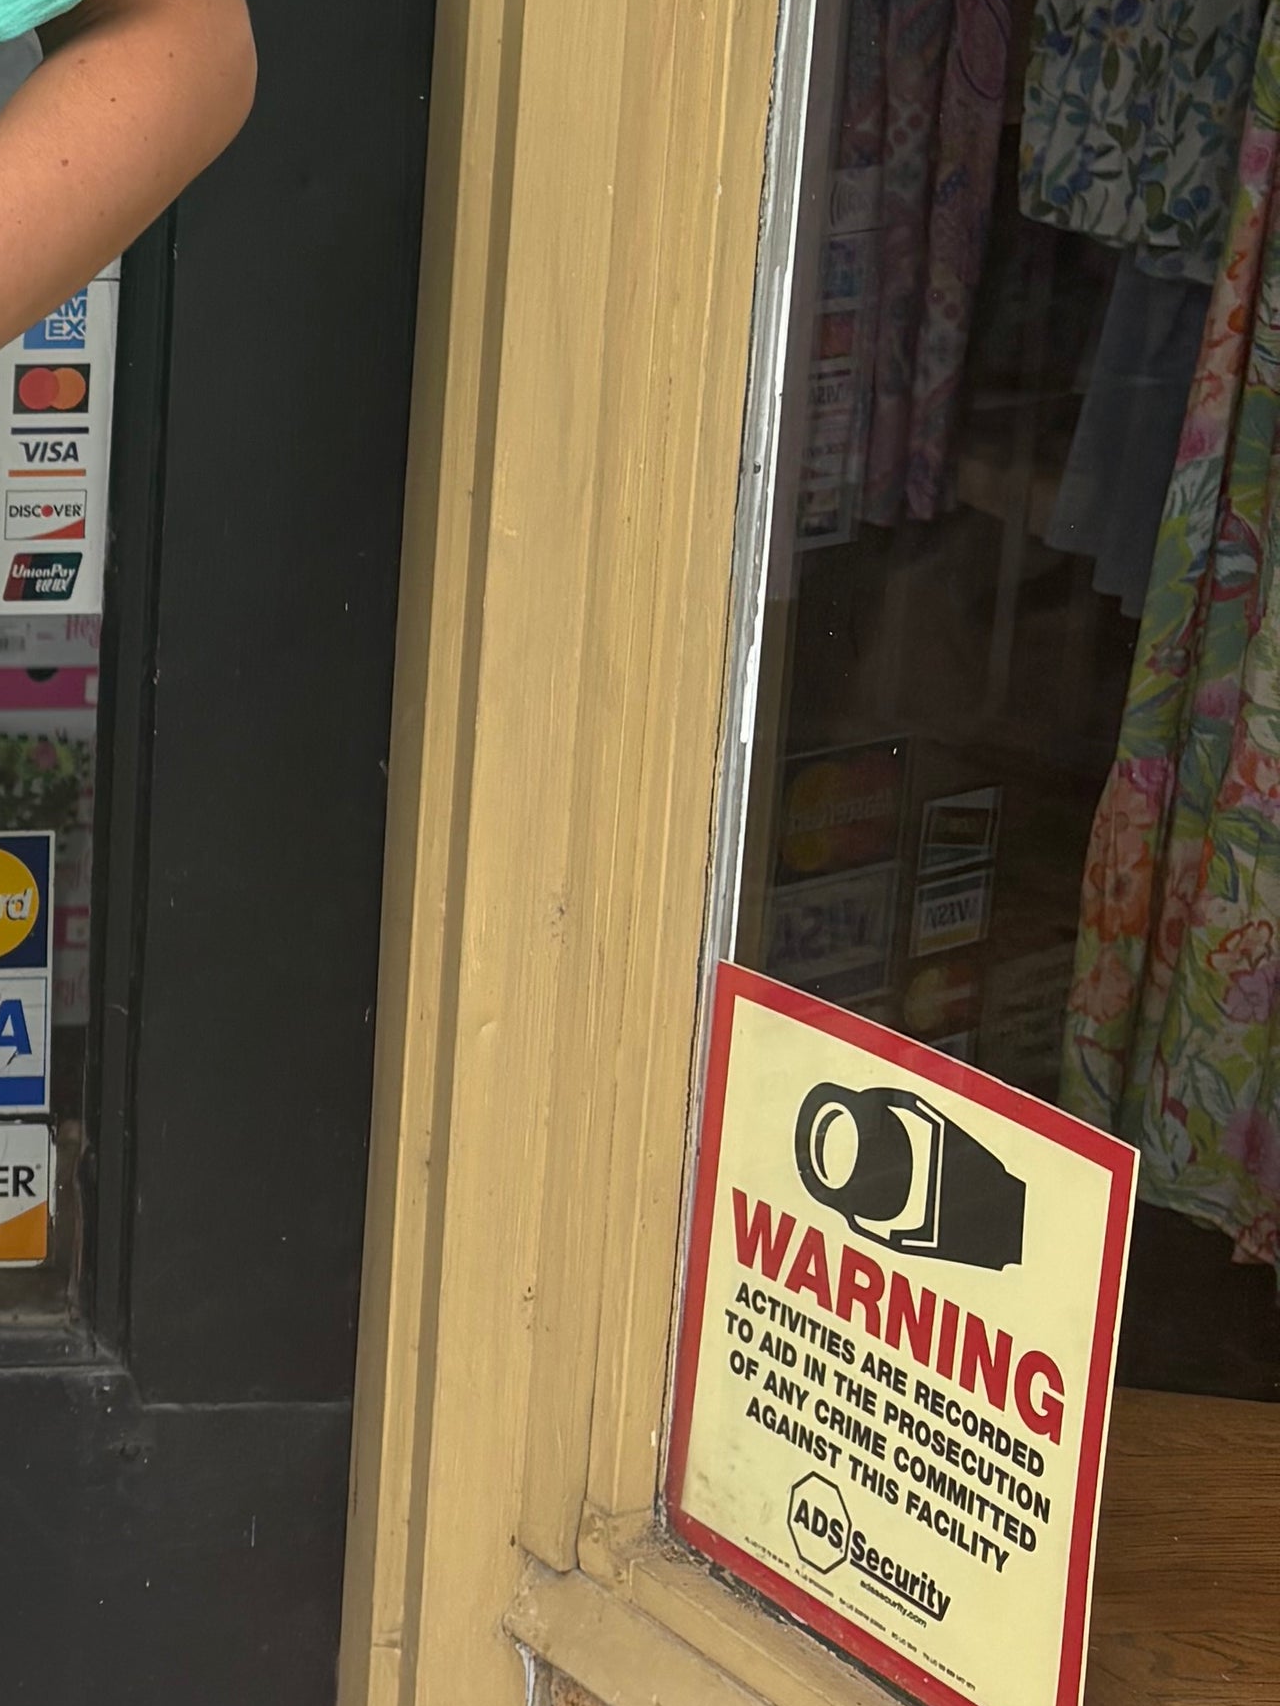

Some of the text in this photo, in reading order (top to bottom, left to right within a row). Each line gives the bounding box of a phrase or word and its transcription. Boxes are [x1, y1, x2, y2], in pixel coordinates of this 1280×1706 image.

[8, 503, 83, 519] DISCOVER
[19, 441, 80, 463] VISA
[12, 562, 76, 581] UnionPay
[732, 1186, 1065, 1446] WARNING
[735, 1282, 1045, 1478] ACTIVITIES ARE RECORDED
[724, 1308, 1051, 1524] TO AID IN THE PROSECUTION
[729, 1349, 1037, 1552] OF ANY CRIME COMMITTED
[745, 1396, 1010, 1573] AGAINST THIS FACILITY
[793, 1498, 844, 1550] ADS
[849, 1530, 951, 1622] Security
